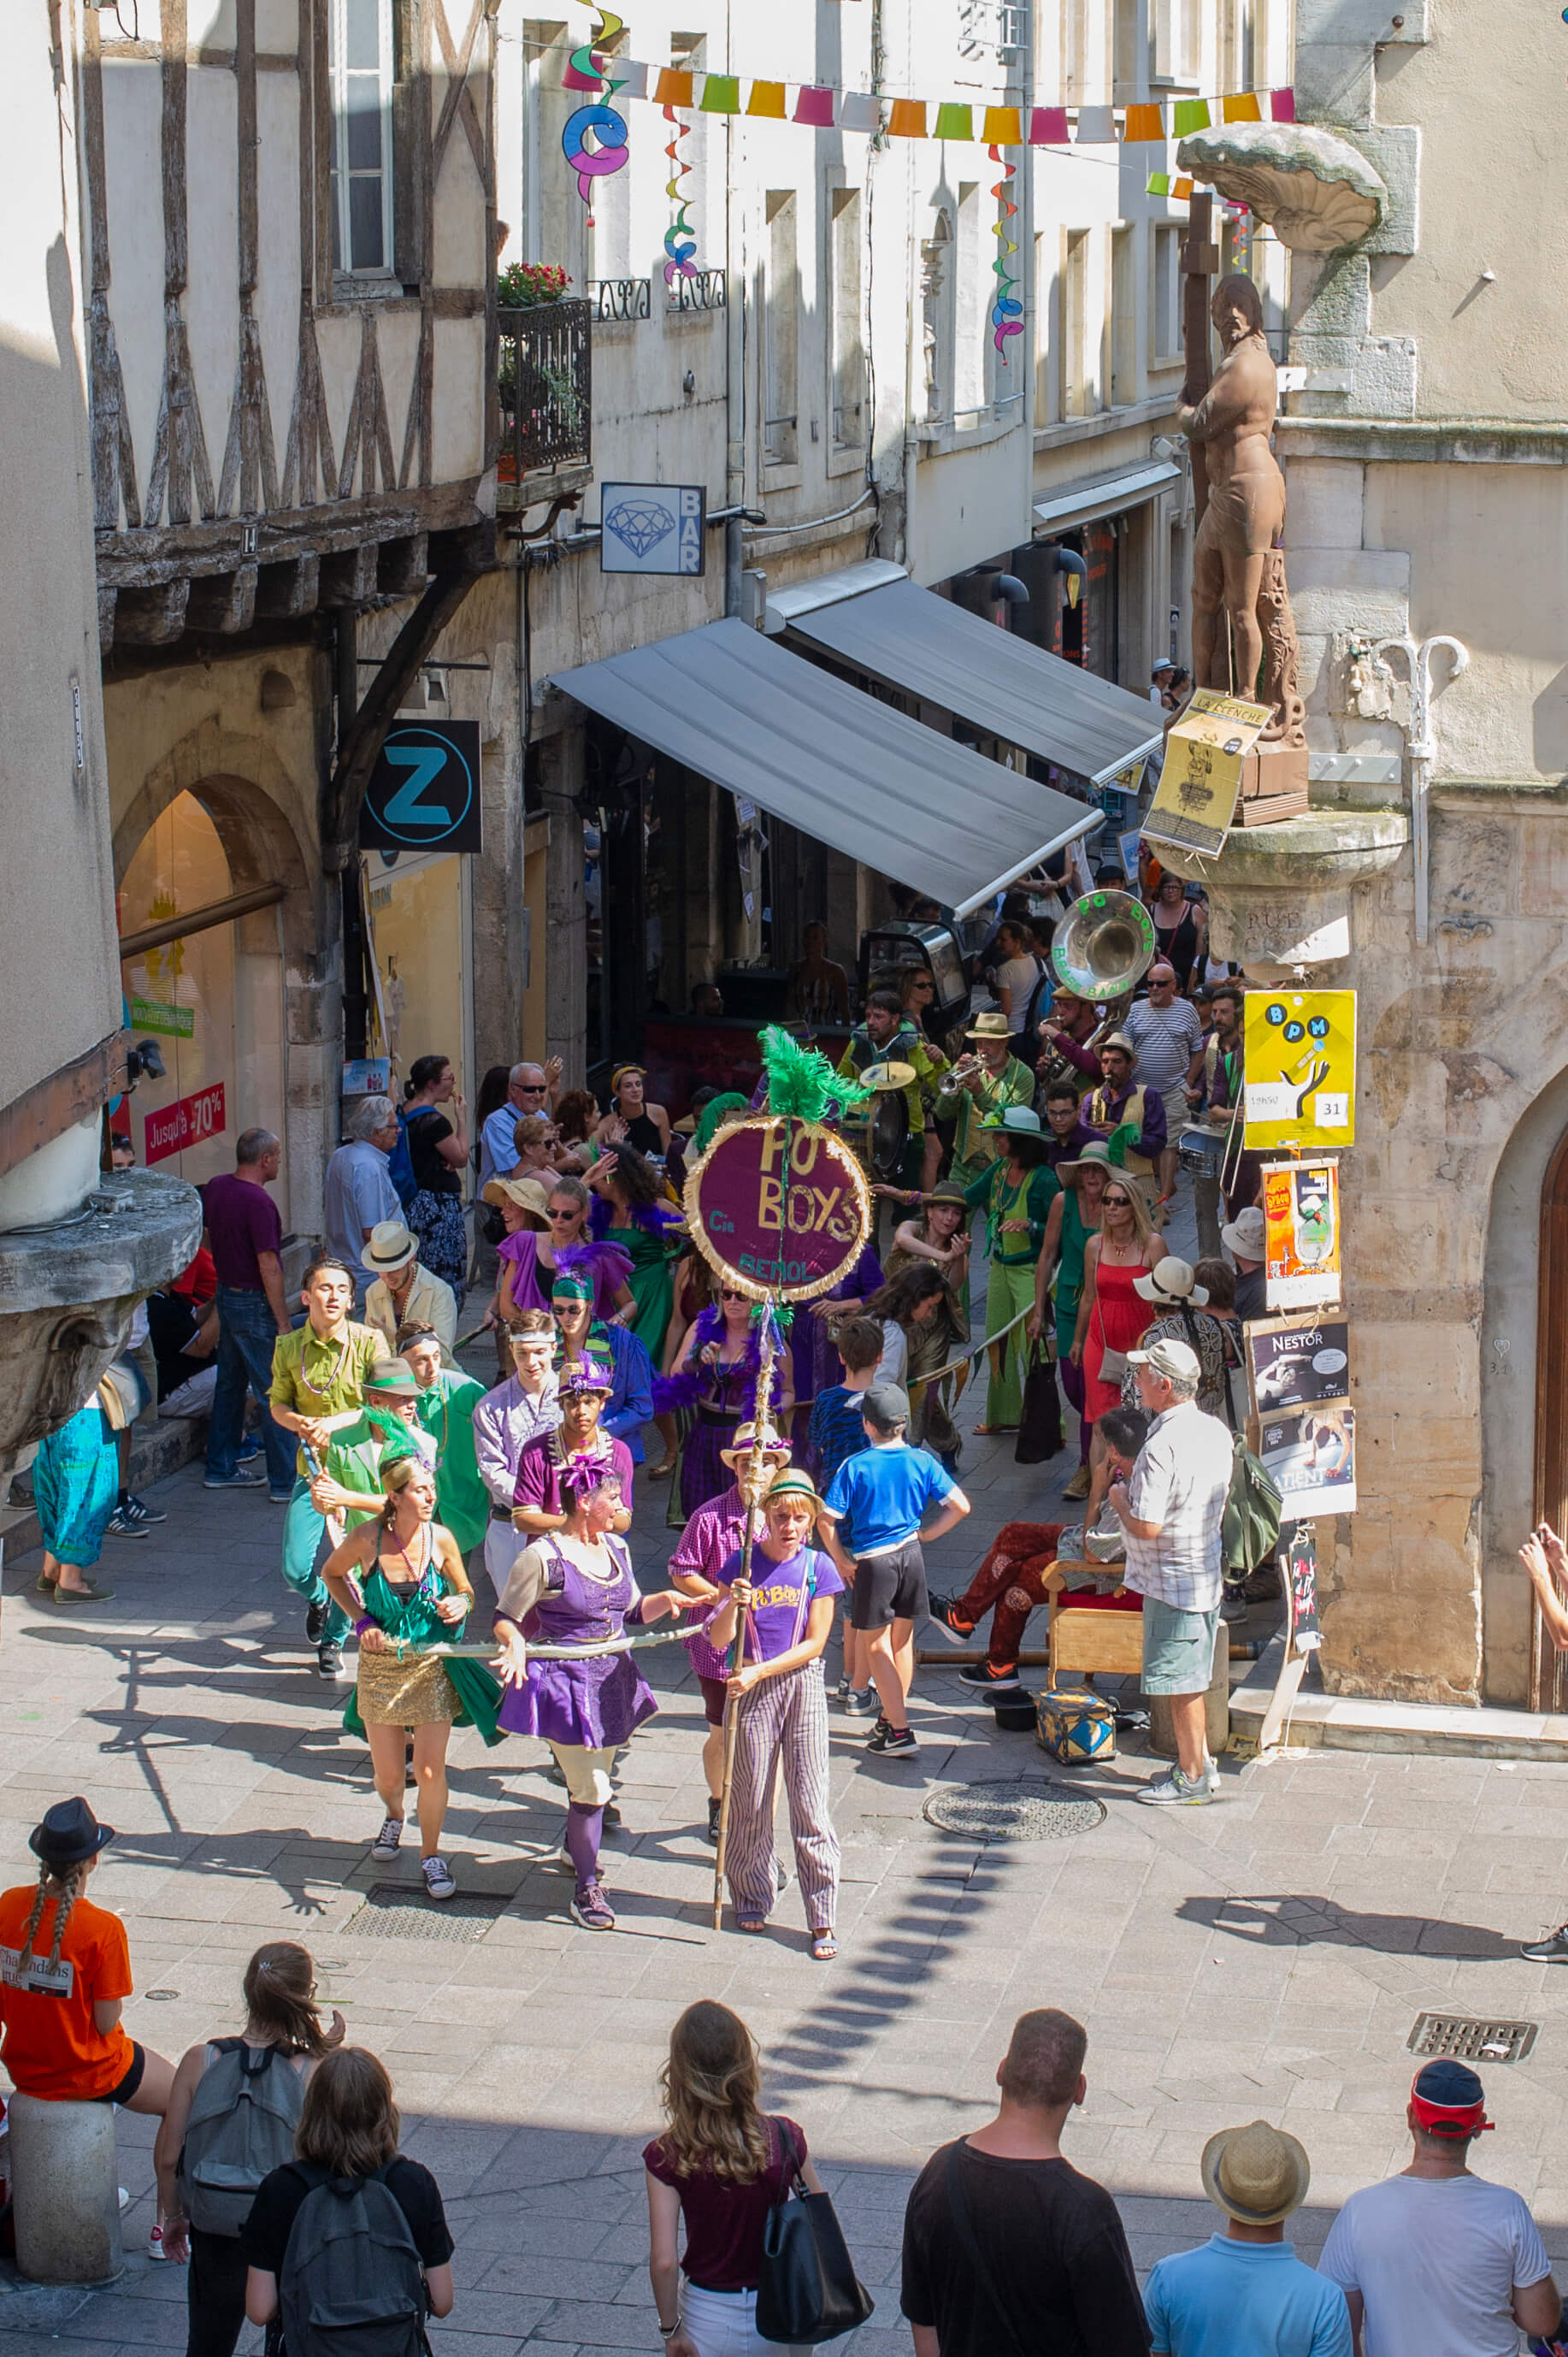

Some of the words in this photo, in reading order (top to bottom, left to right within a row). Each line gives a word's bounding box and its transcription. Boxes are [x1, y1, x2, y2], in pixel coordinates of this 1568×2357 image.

[681, 488, 700, 572] BAR
[1197, 699, 1210, 709] LA
[1212, 704, 1264, 723] CLENCHE
[384, 747, 451, 824] Z
[150, 1109, 187, 1149] Jusqu'à
[1323, 1103, 1341, 1115] 31
[758, 1175, 861, 1243] BOYS
[1272, 1334, 1323, 1353] NESTOR
